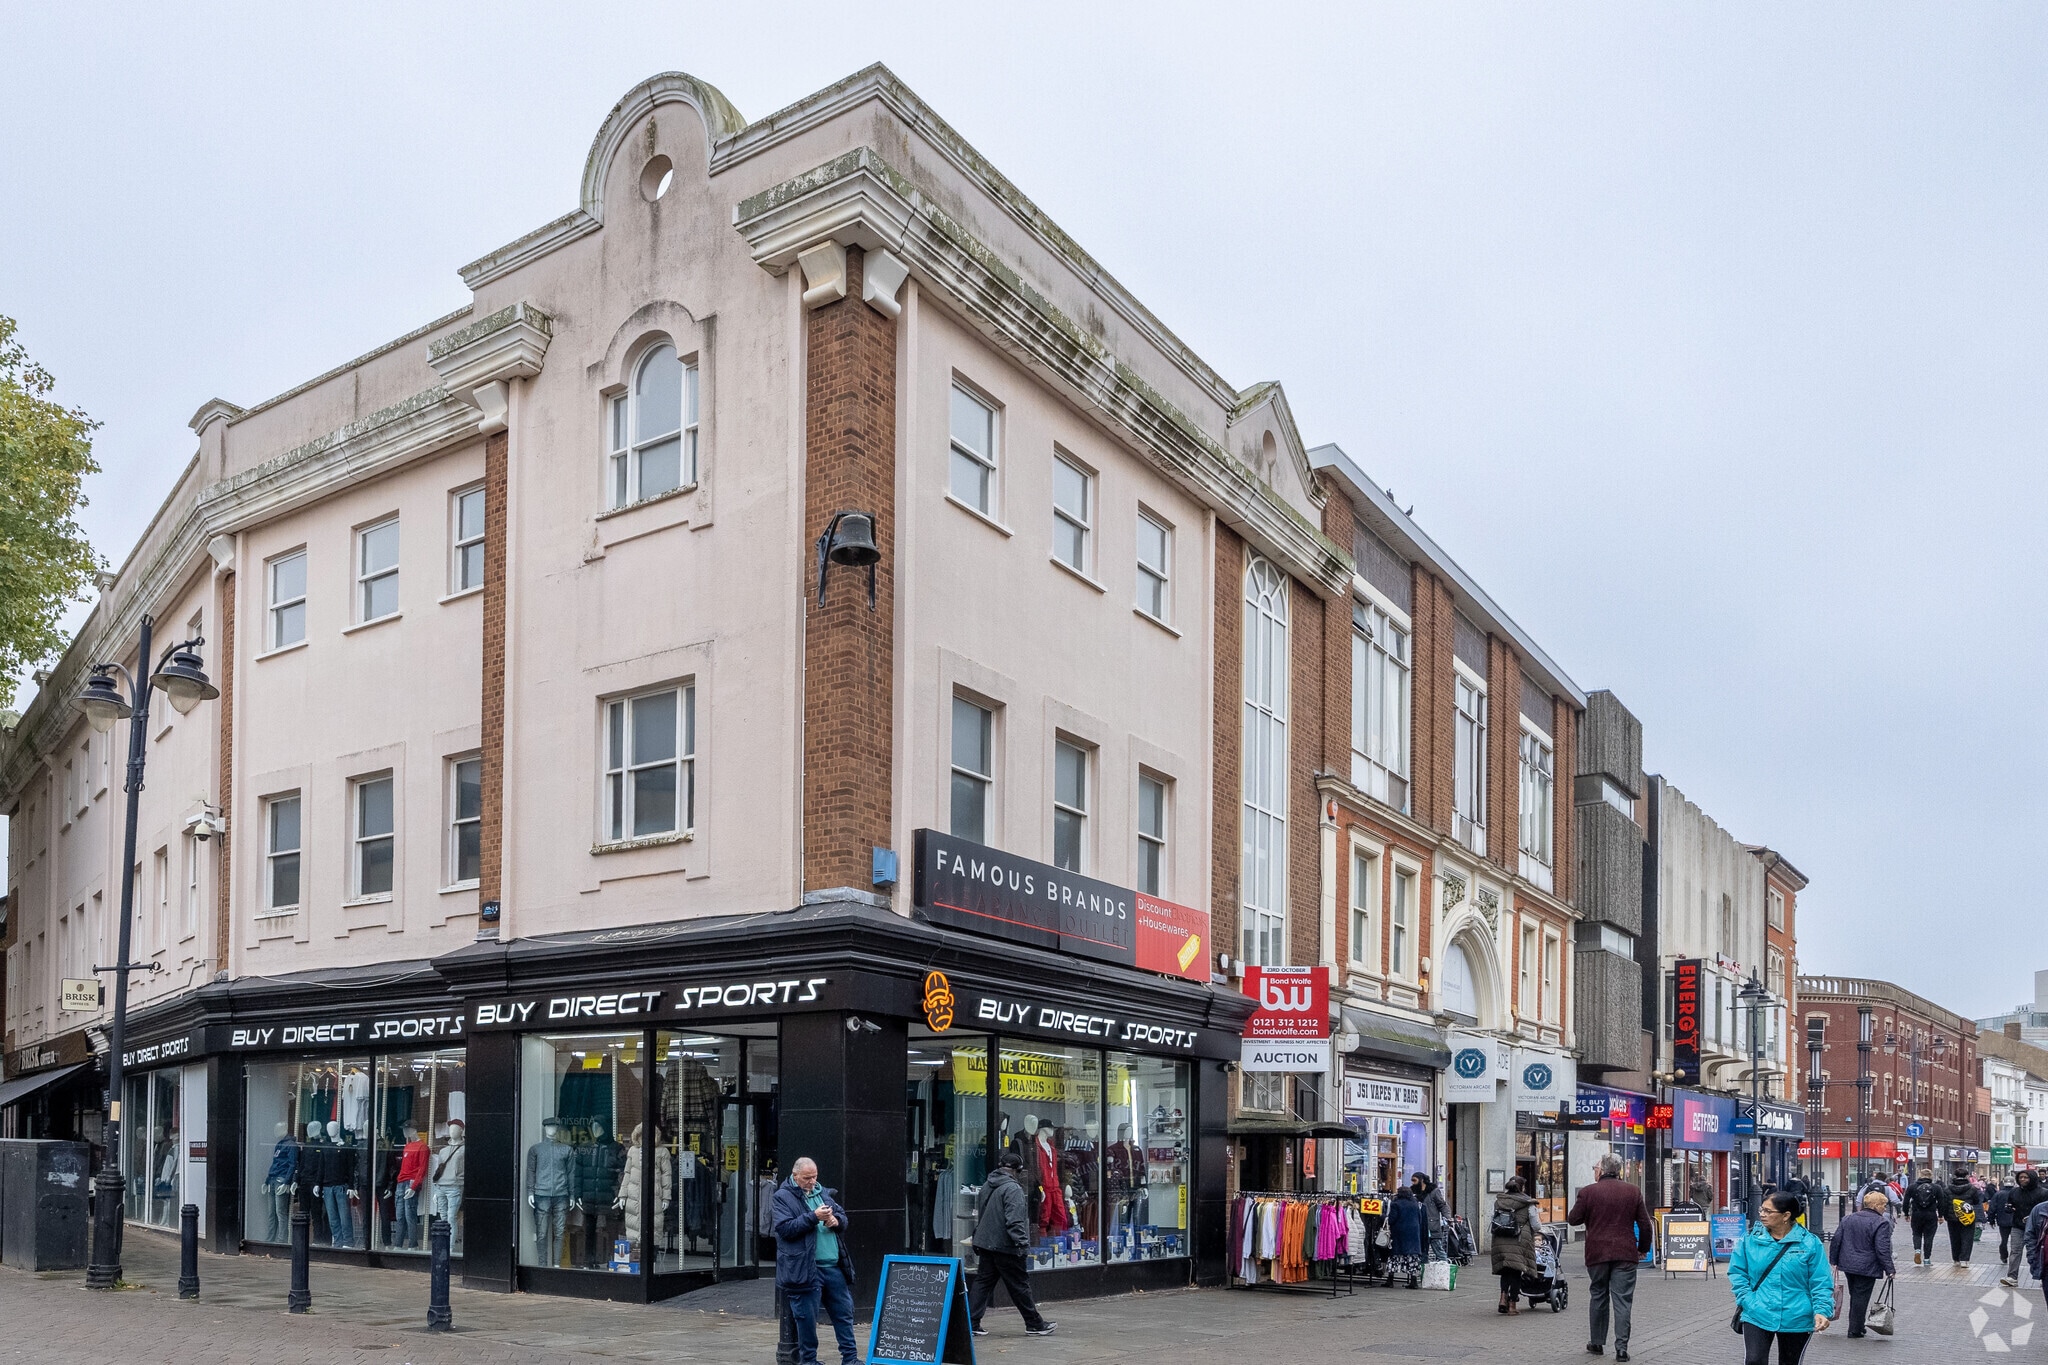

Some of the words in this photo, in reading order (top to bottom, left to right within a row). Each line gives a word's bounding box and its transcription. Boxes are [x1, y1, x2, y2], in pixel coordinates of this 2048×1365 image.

[936, 849, 1034, 895] FAMOUS
[1047, 881, 1127, 920] BRANDS
[1138, 898, 1172, 918] Discount
[65, 992, 96, 1002] BRISK
[476, 1001, 537, 1025] BUY
[548, 991, 662, 1019] DIRECT
[674, 978, 827, 1010] SPORTS
[1675, 965, 1700, 1054] ENERGY
[231, 1028, 275, 1046] BUY
[282, 1023, 360, 1044] DIRECT
[369, 1016, 465, 1040] SPORTS
[978, 998, 1032, 1024] BUY
[1038, 1008, 1116, 1036] DIRECT
[1121, 1022, 1198, 1048] SPORTS
[1253, 1018, 1275, 1026] 0121
[1278, 1018, 1294, 1026] 312
[1298, 1018, 1318, 1026] 1212
[21, 1044, 40, 1070] BRISK
[122, 1052, 136, 1066] BUY
[136, 1045, 160, 1064] DIRECT
[161, 1036, 190, 1058] SPORTS
[1253, 1052, 1318, 1064] AUCTION
[1018, 1059, 1064, 1076] CLOTHING
[1465, 1058, 1476, 1070] V
[1533, 1072, 1542, 1082] V
[1007, 1078, 1045, 1093] BRANDS
[1054, 1082, 1072, 1096] LOW
[1356, 1082, 1368, 1098] JSI
[1370, 1084, 1392, 1101] VAPES
[1403, 1088, 1418, 1104] BAGS
[1692, 1112, 1719, 1133] BETFRED
[1364, 1200, 1380, 1211] £2
[886, 1295, 904, 1304] Tuna
[876, 1348, 906, 1359] TURKEY
